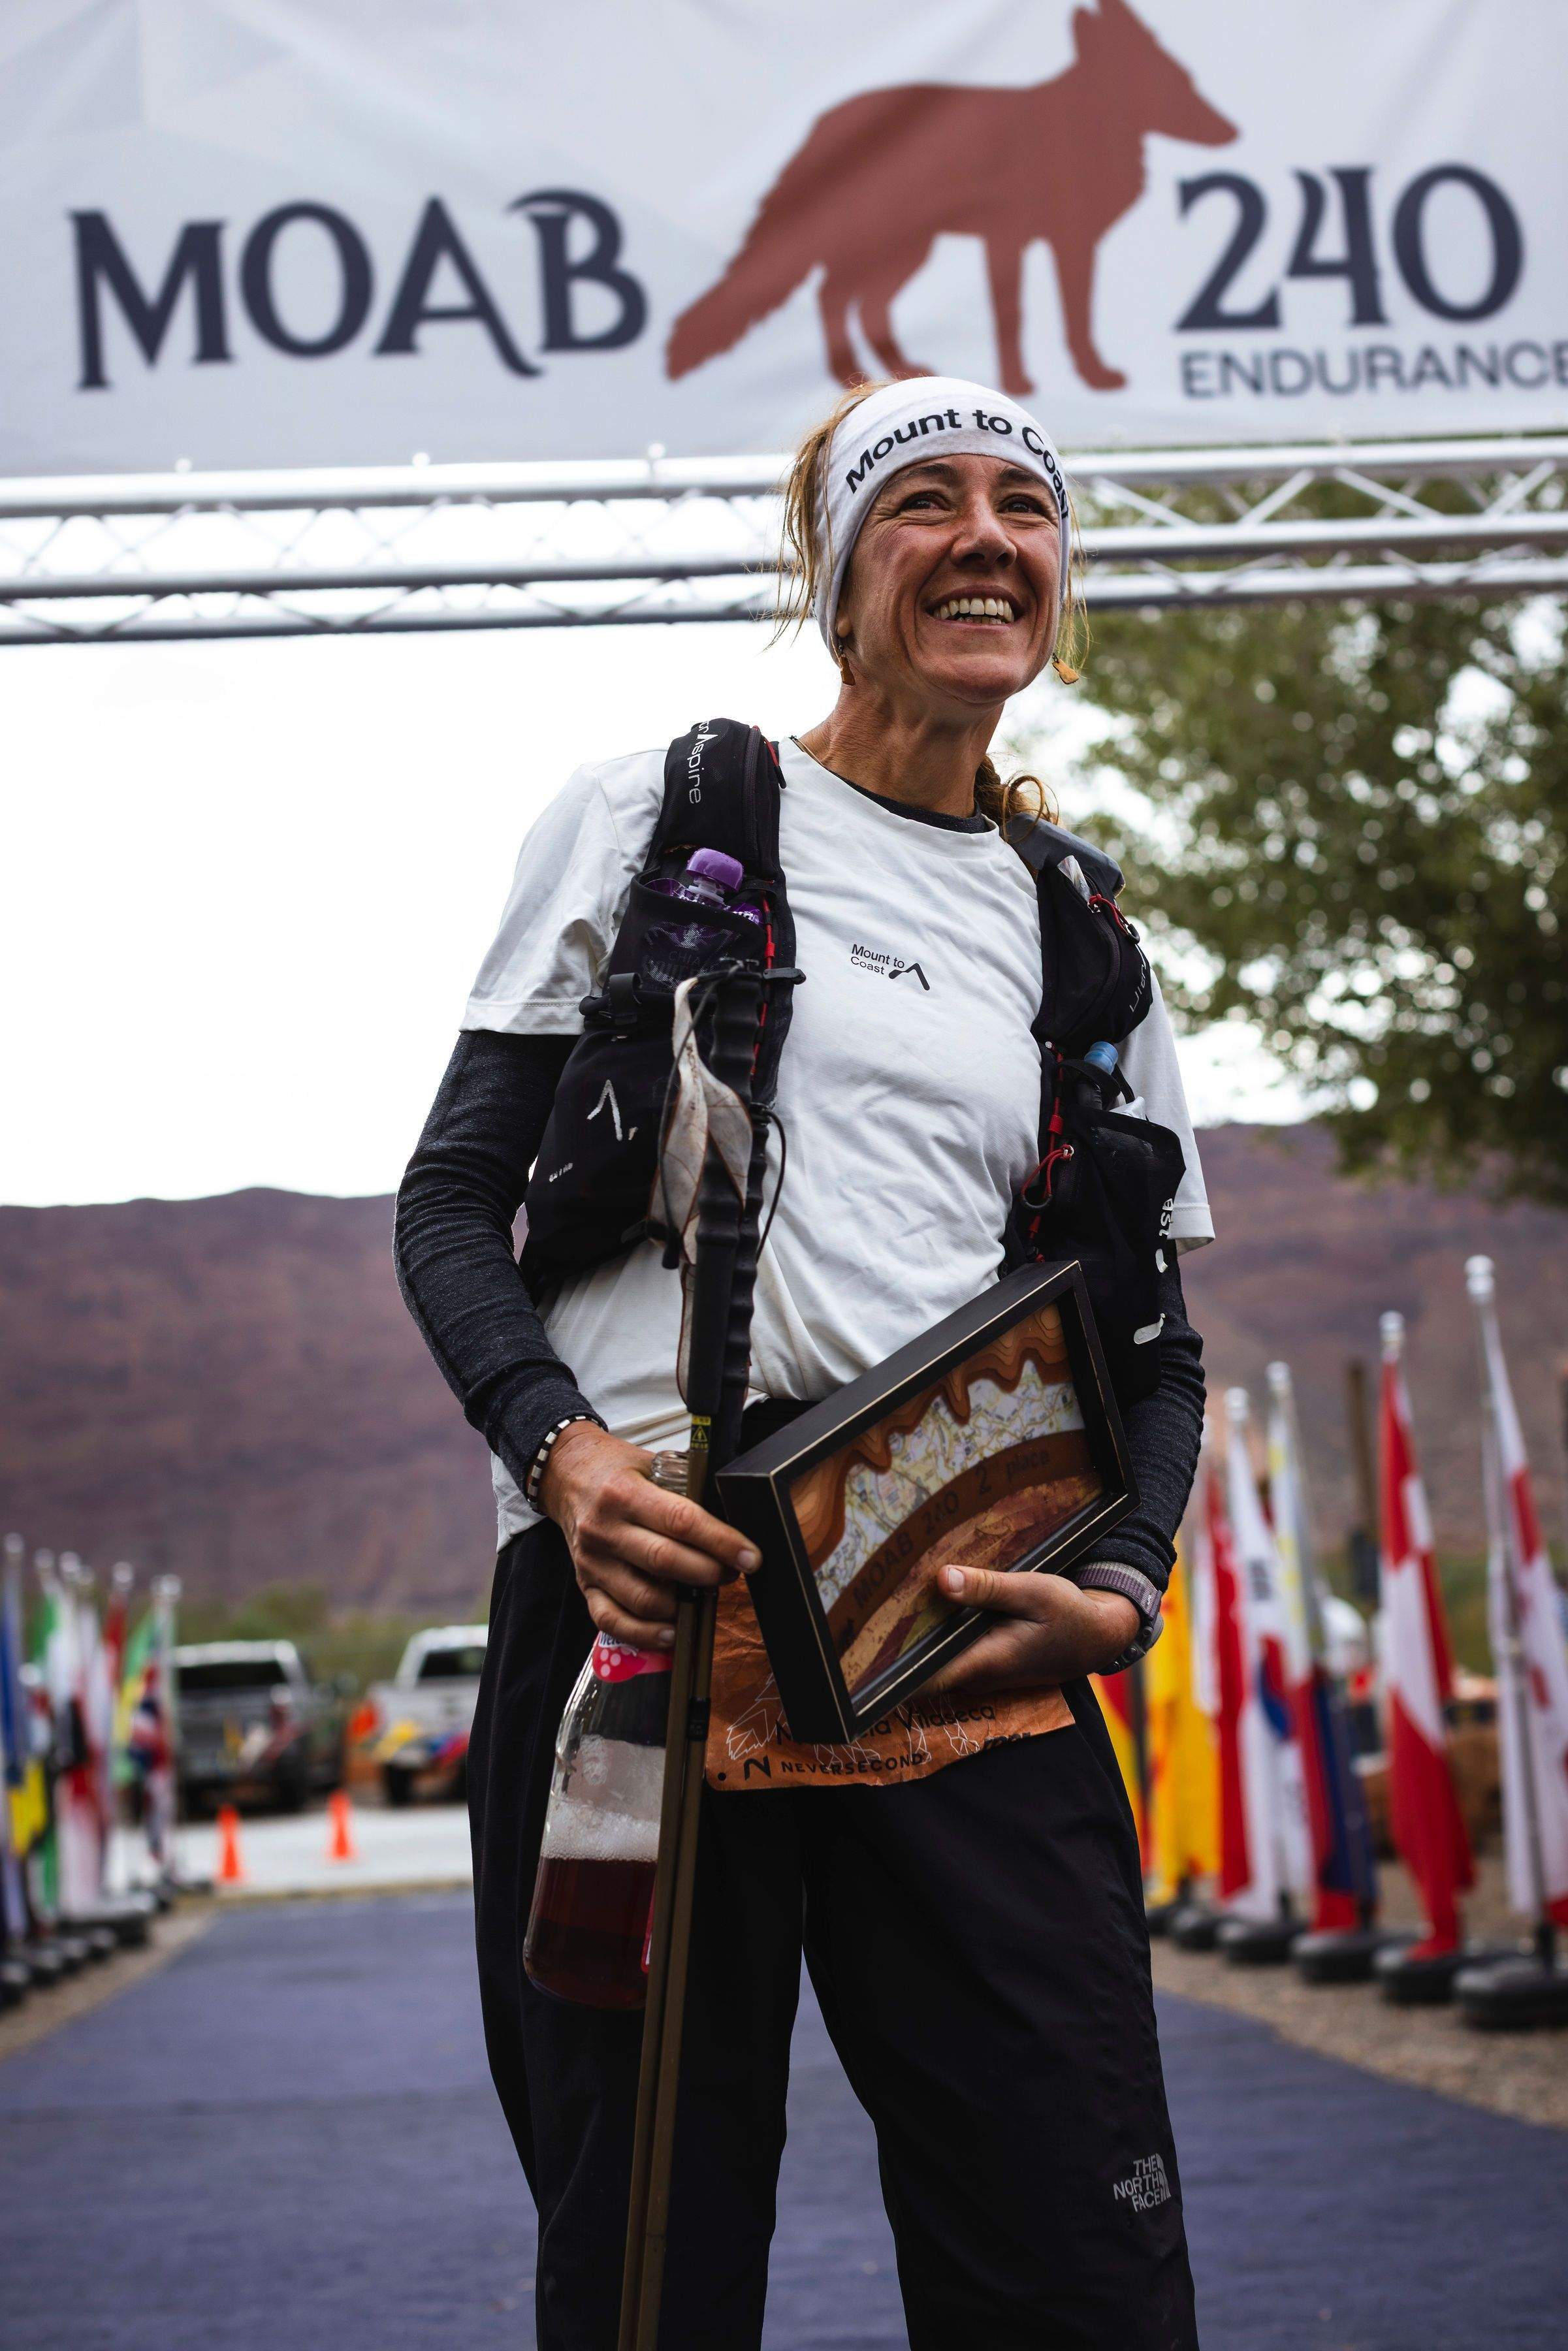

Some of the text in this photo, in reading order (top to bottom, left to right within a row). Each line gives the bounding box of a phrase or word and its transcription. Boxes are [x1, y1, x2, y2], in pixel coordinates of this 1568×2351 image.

[69, 163, 1526, 392] MOAB 240
[845, 409, 962, 494] Mount
[972, 409, 1013, 435] to
[850, 956, 885, 975] Coast
[851, 944, 905, 968] Mount to
[853, 1531, 913, 1607] MOAB
[923, 1490, 960, 1533] 240
[781, 1753, 922, 1775] NEVERSECOND
[1133, 2154, 1157, 2176] THE
[1113, 2171, 1160, 2200] NORTH
[1131, 2188, 1161, 2213] FACE
